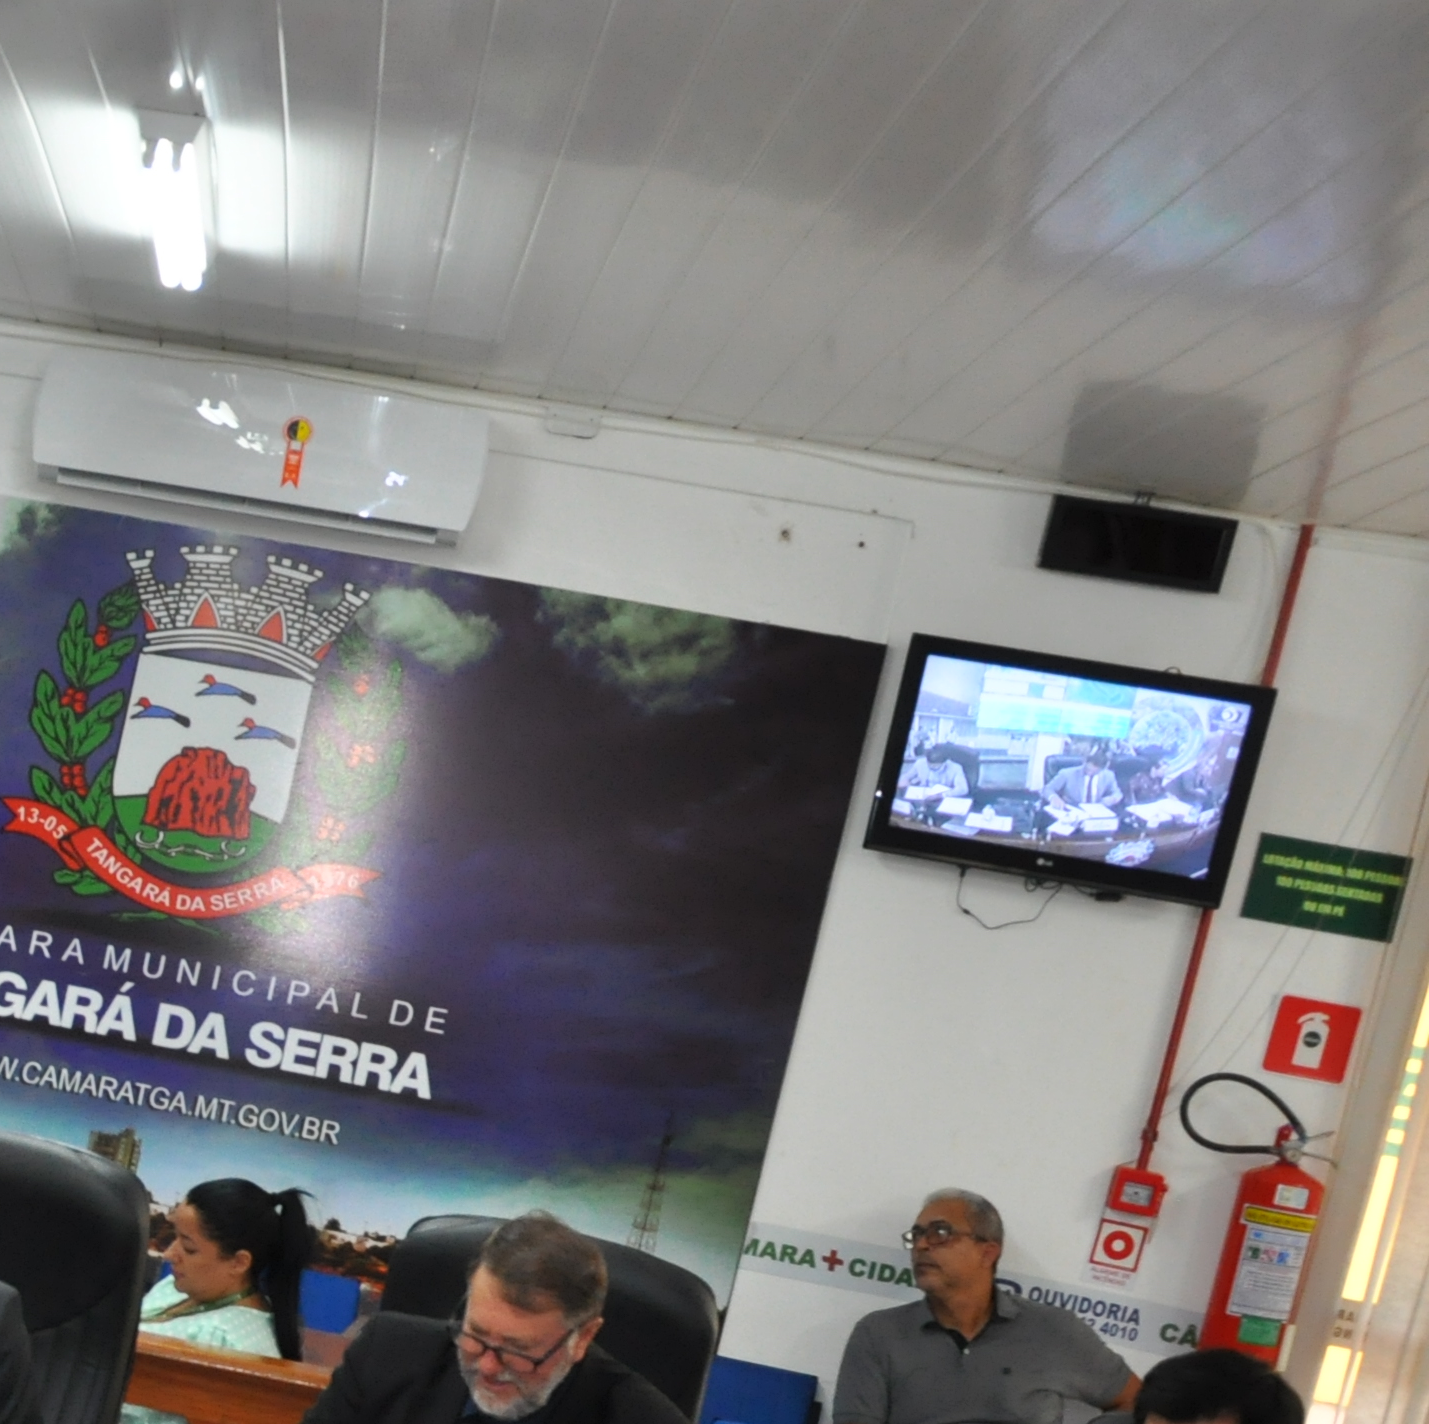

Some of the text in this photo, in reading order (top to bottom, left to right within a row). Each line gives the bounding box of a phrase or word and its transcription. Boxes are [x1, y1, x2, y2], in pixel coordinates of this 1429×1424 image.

[16, 806, 68, 840] 13-05
[86, 838, 285, 912] TANGARÁ DA SERRA
[102, 944, 368, 1020] MUNICIPAL
[388, 999, 449, 1035] DE
[151, 1002, 230, 1060] DA
[244, 1021, 432, 1100] SERRA
[1028, 1286, 1141, 1326] OUVIDORIA
[1100, 1322, 1138, 1342] 4010
